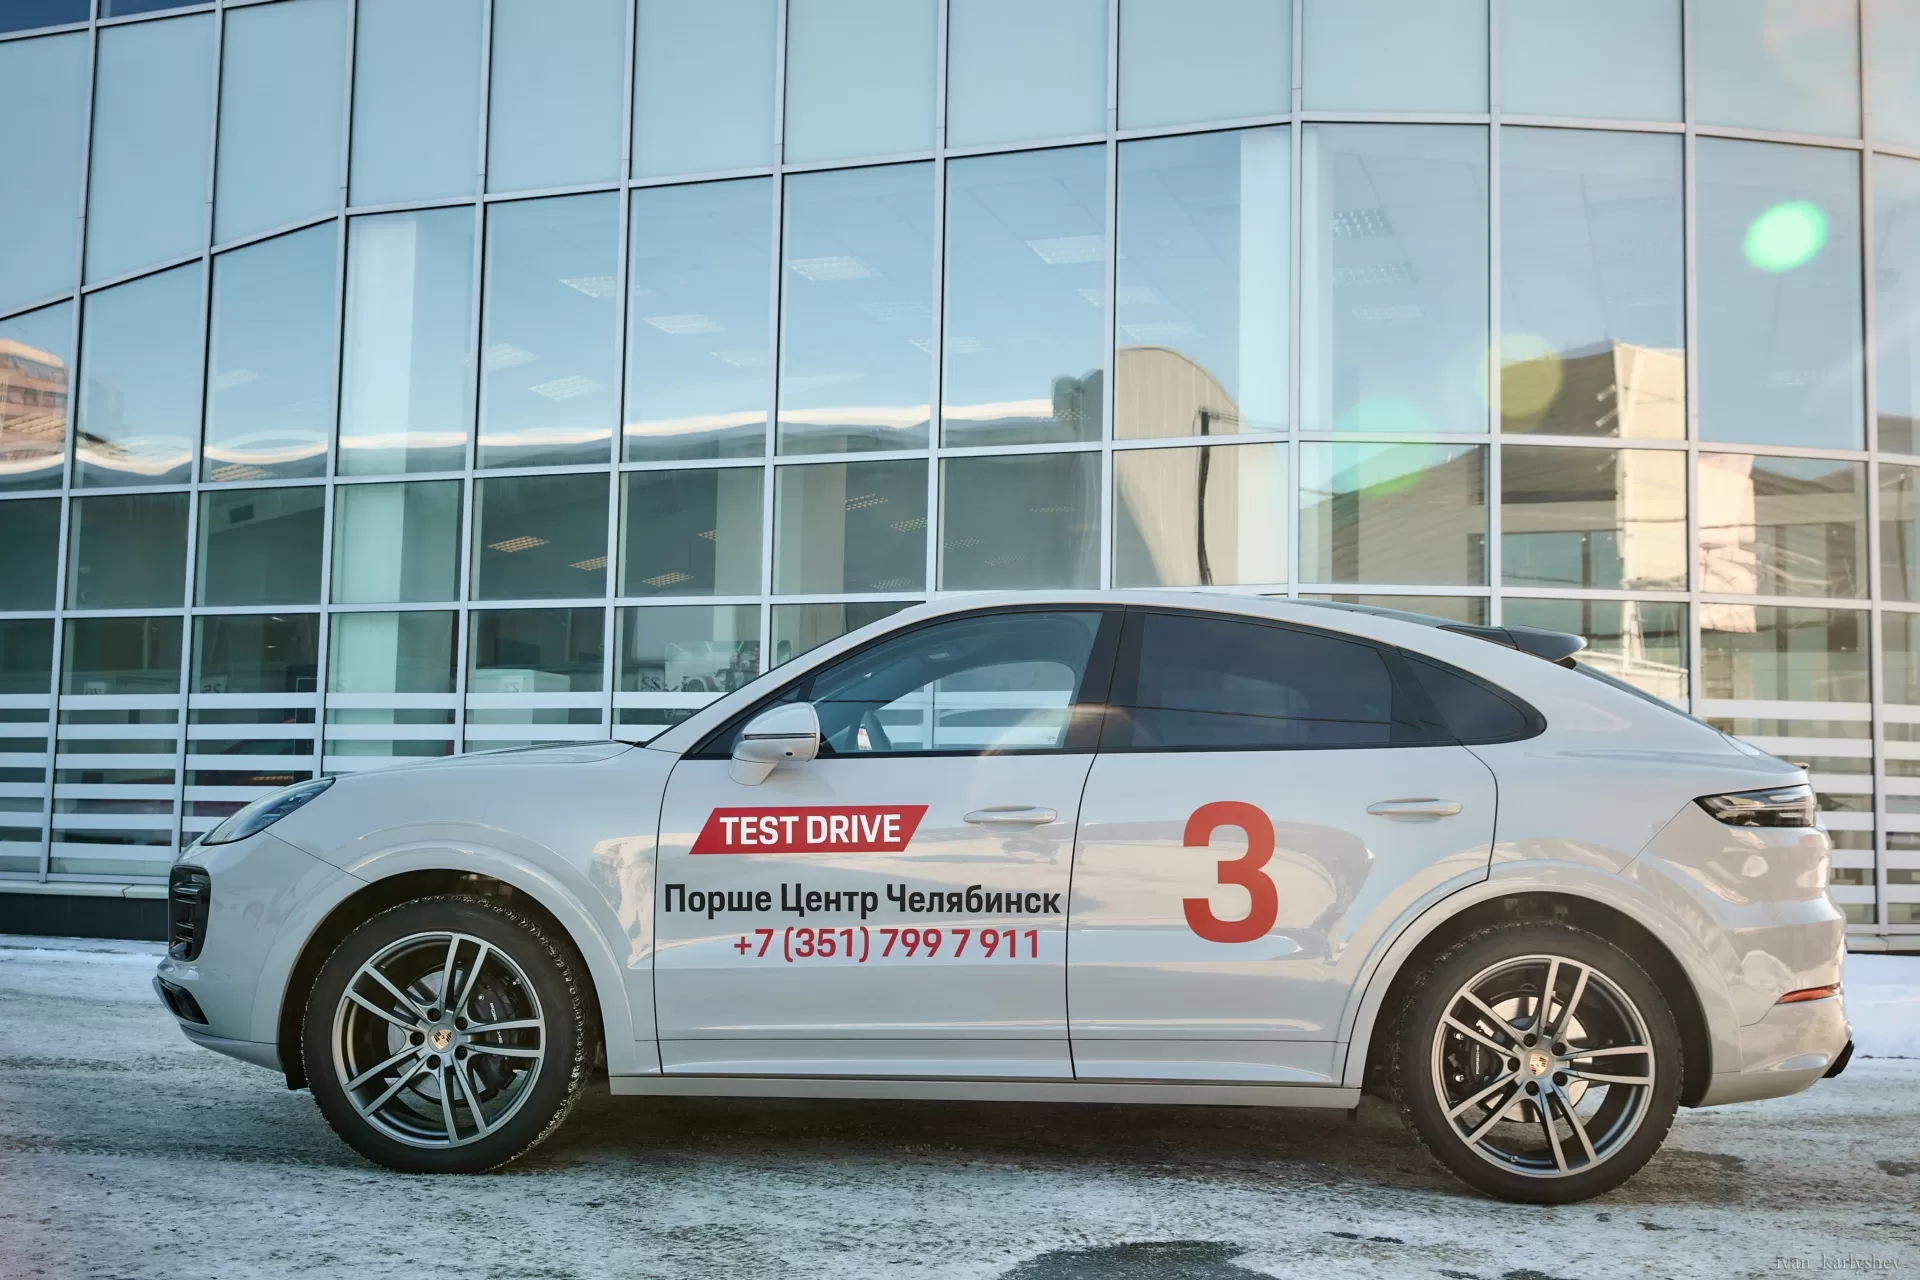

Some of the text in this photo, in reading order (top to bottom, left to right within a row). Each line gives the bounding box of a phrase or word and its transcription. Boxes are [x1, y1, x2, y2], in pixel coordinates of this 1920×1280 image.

[719, 813, 902, 845] TEST DRIVE
[1182, 800, 1279, 944] 3
[664, 882, 1061, 920] Порше Центр Челябинск
[733, 926, 1040, 963] +7 (351) 799 7 911
